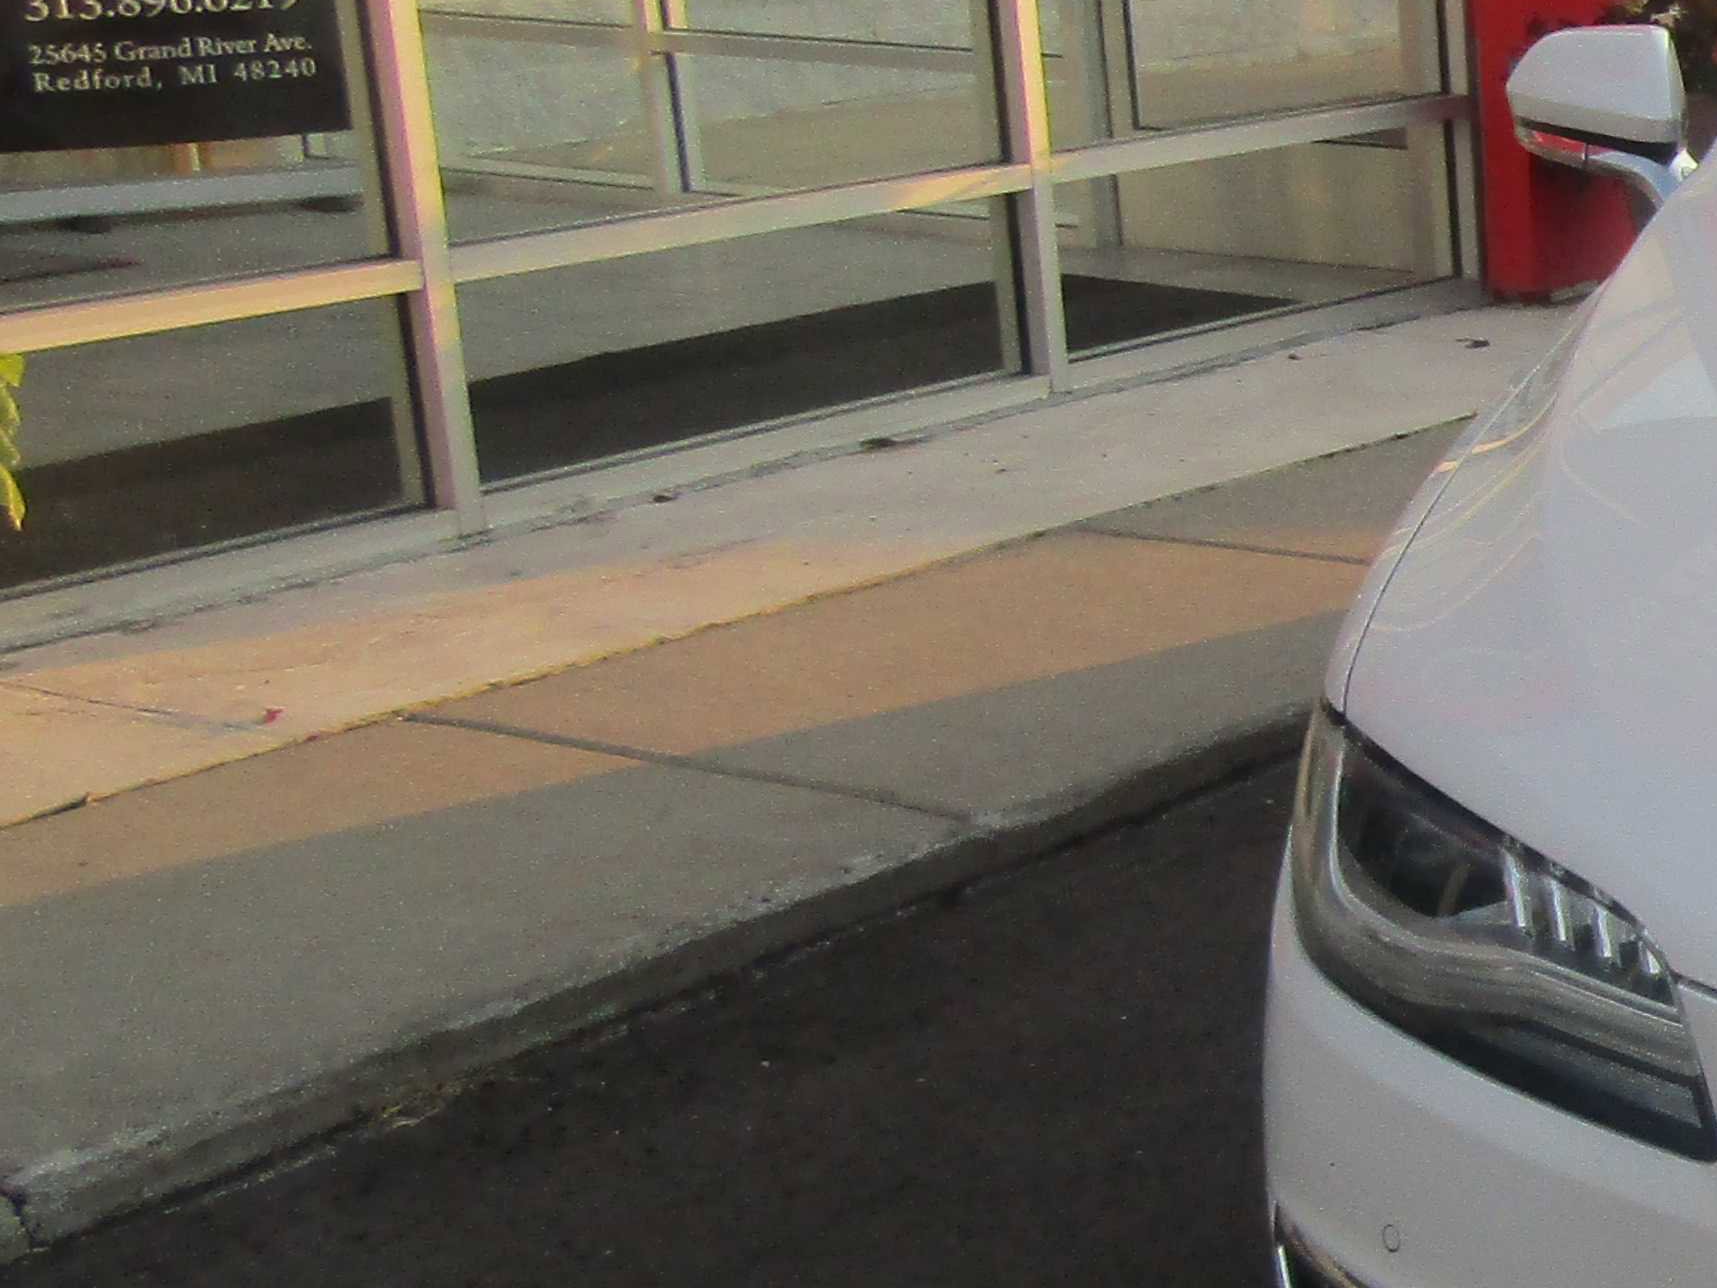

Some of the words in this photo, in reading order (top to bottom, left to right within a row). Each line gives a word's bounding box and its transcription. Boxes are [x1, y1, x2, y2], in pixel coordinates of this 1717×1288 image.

[28, 41, 106, 65] 25645
[114, 37, 193, 62] Grand
[199, 34, 257, 58] River
[264, 32, 312, 53] Ave.
[32, 66, 162, 94] Redford,
[178, 63, 218, 86] MI
[233, 57, 316, 82] 48240
